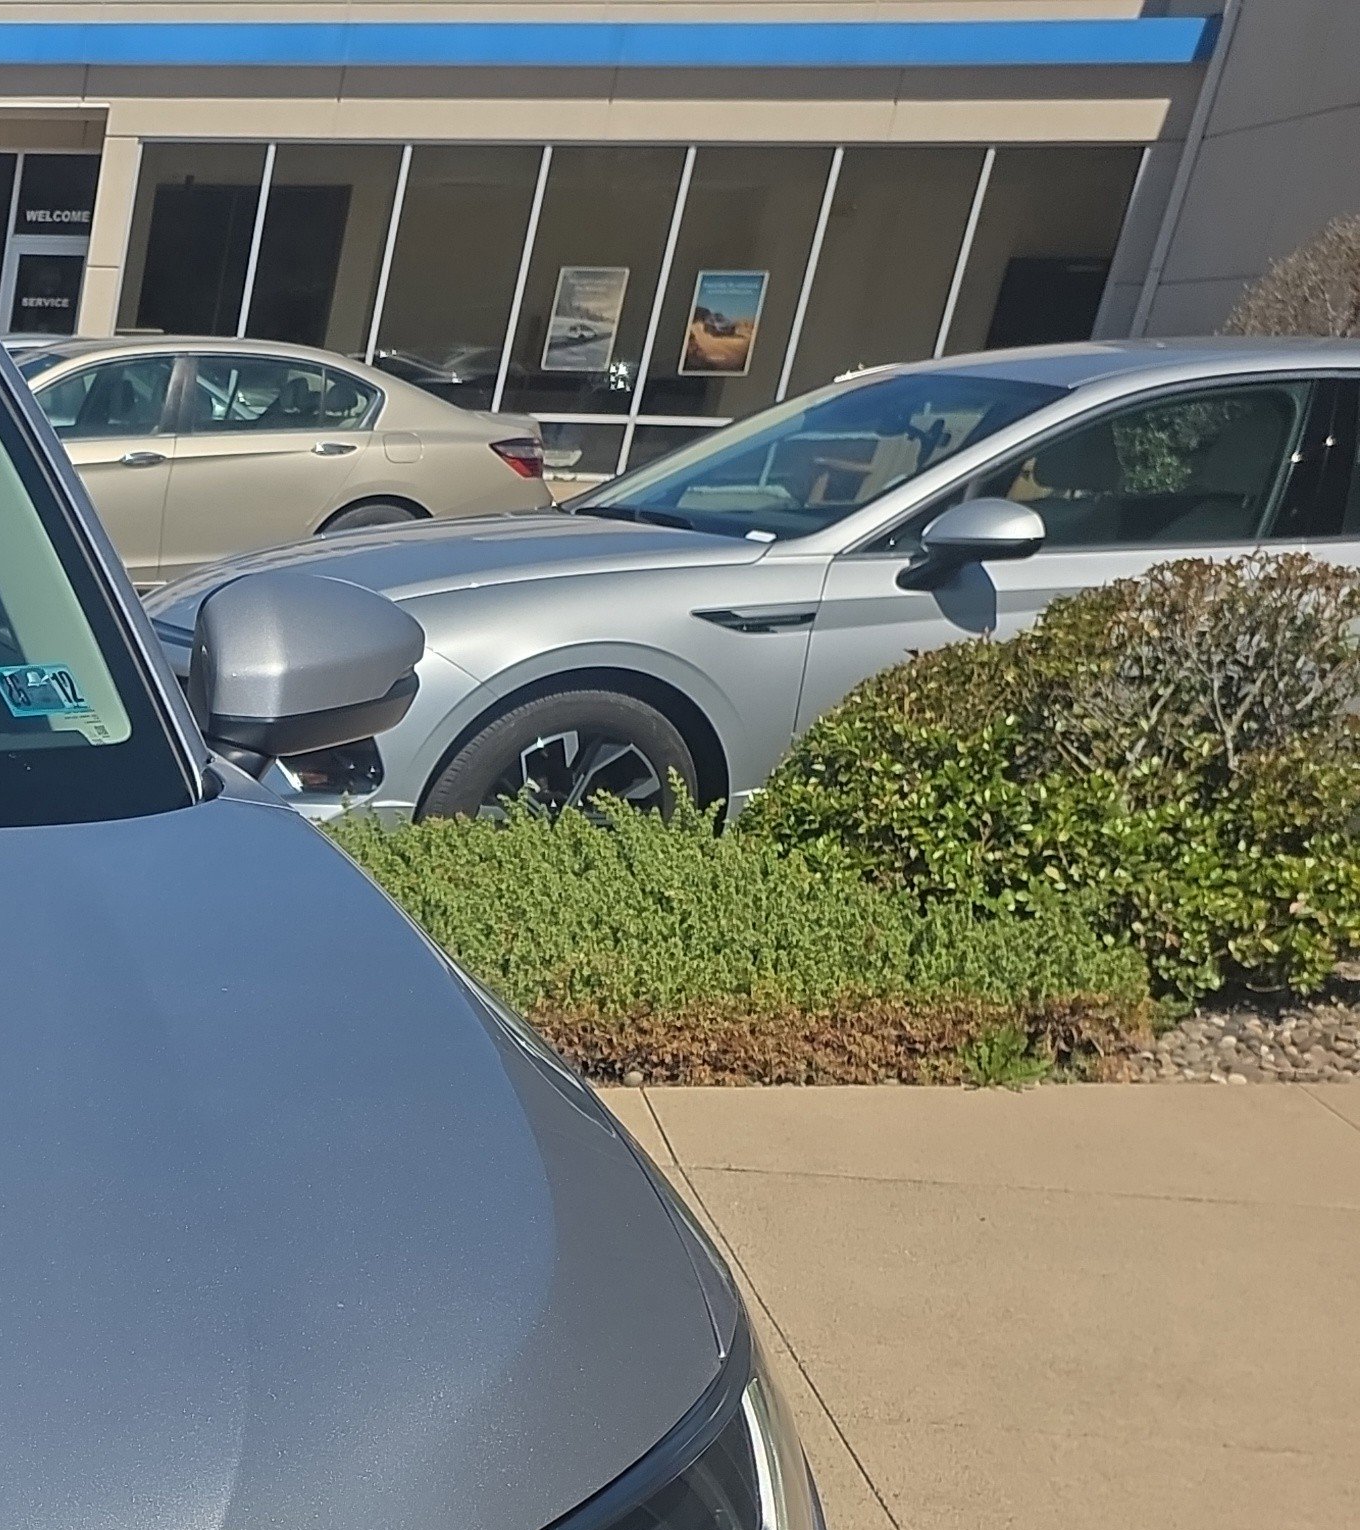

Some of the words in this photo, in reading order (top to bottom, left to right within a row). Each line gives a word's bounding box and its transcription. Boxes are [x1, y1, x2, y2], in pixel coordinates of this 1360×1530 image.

[25, 209, 91, 223] WELCOME
[21, 297, 70, 308] SERVICE
[51, 670, 85, 703] 12
